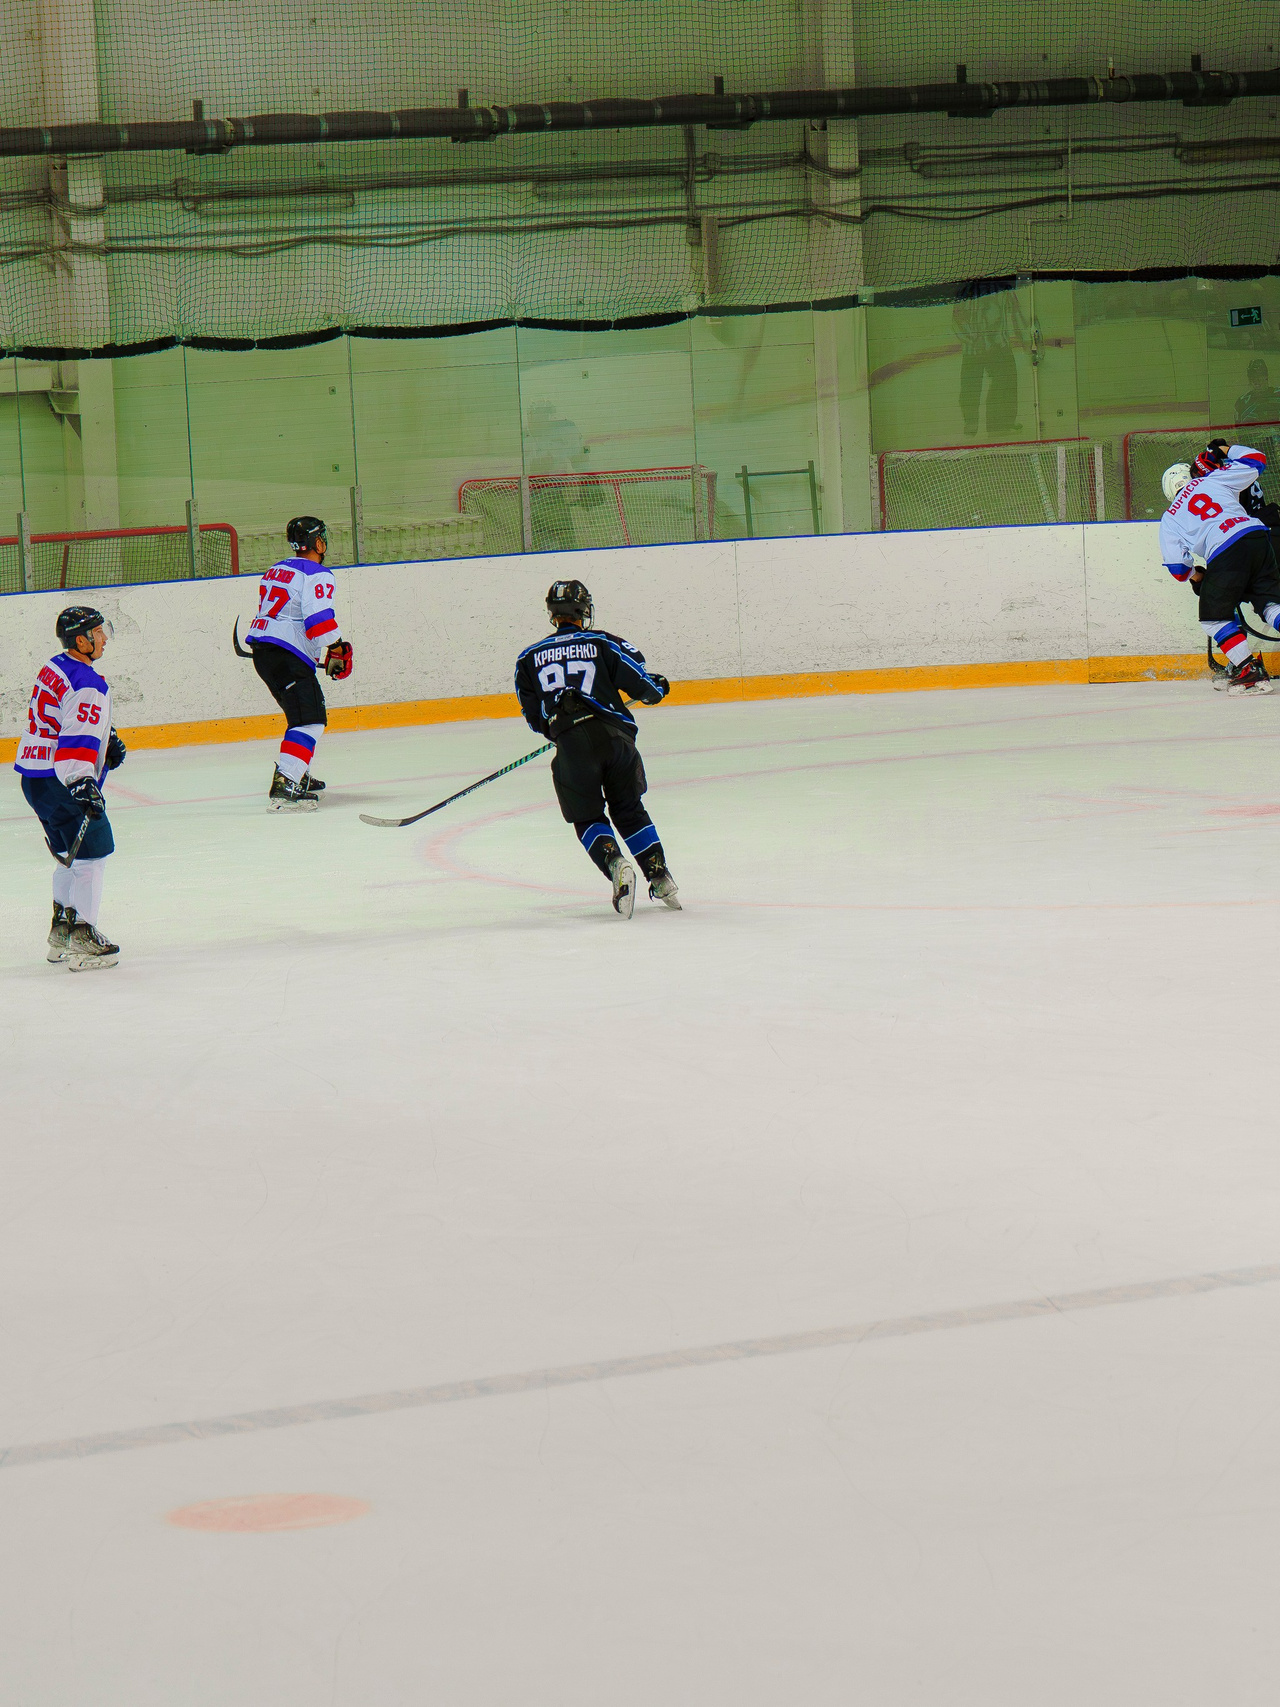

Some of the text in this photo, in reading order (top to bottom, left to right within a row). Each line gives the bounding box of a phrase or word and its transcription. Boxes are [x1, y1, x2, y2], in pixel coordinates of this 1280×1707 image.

[1188, 493, 1223, 521] 8
[314, 583, 335, 600] 87
[534, 643, 598, 667] КРАВЧЕНКО
[537, 660, 597, 696] 97
[77, 702, 102, 725] 55
[78, 814, 90, 841] CCM
